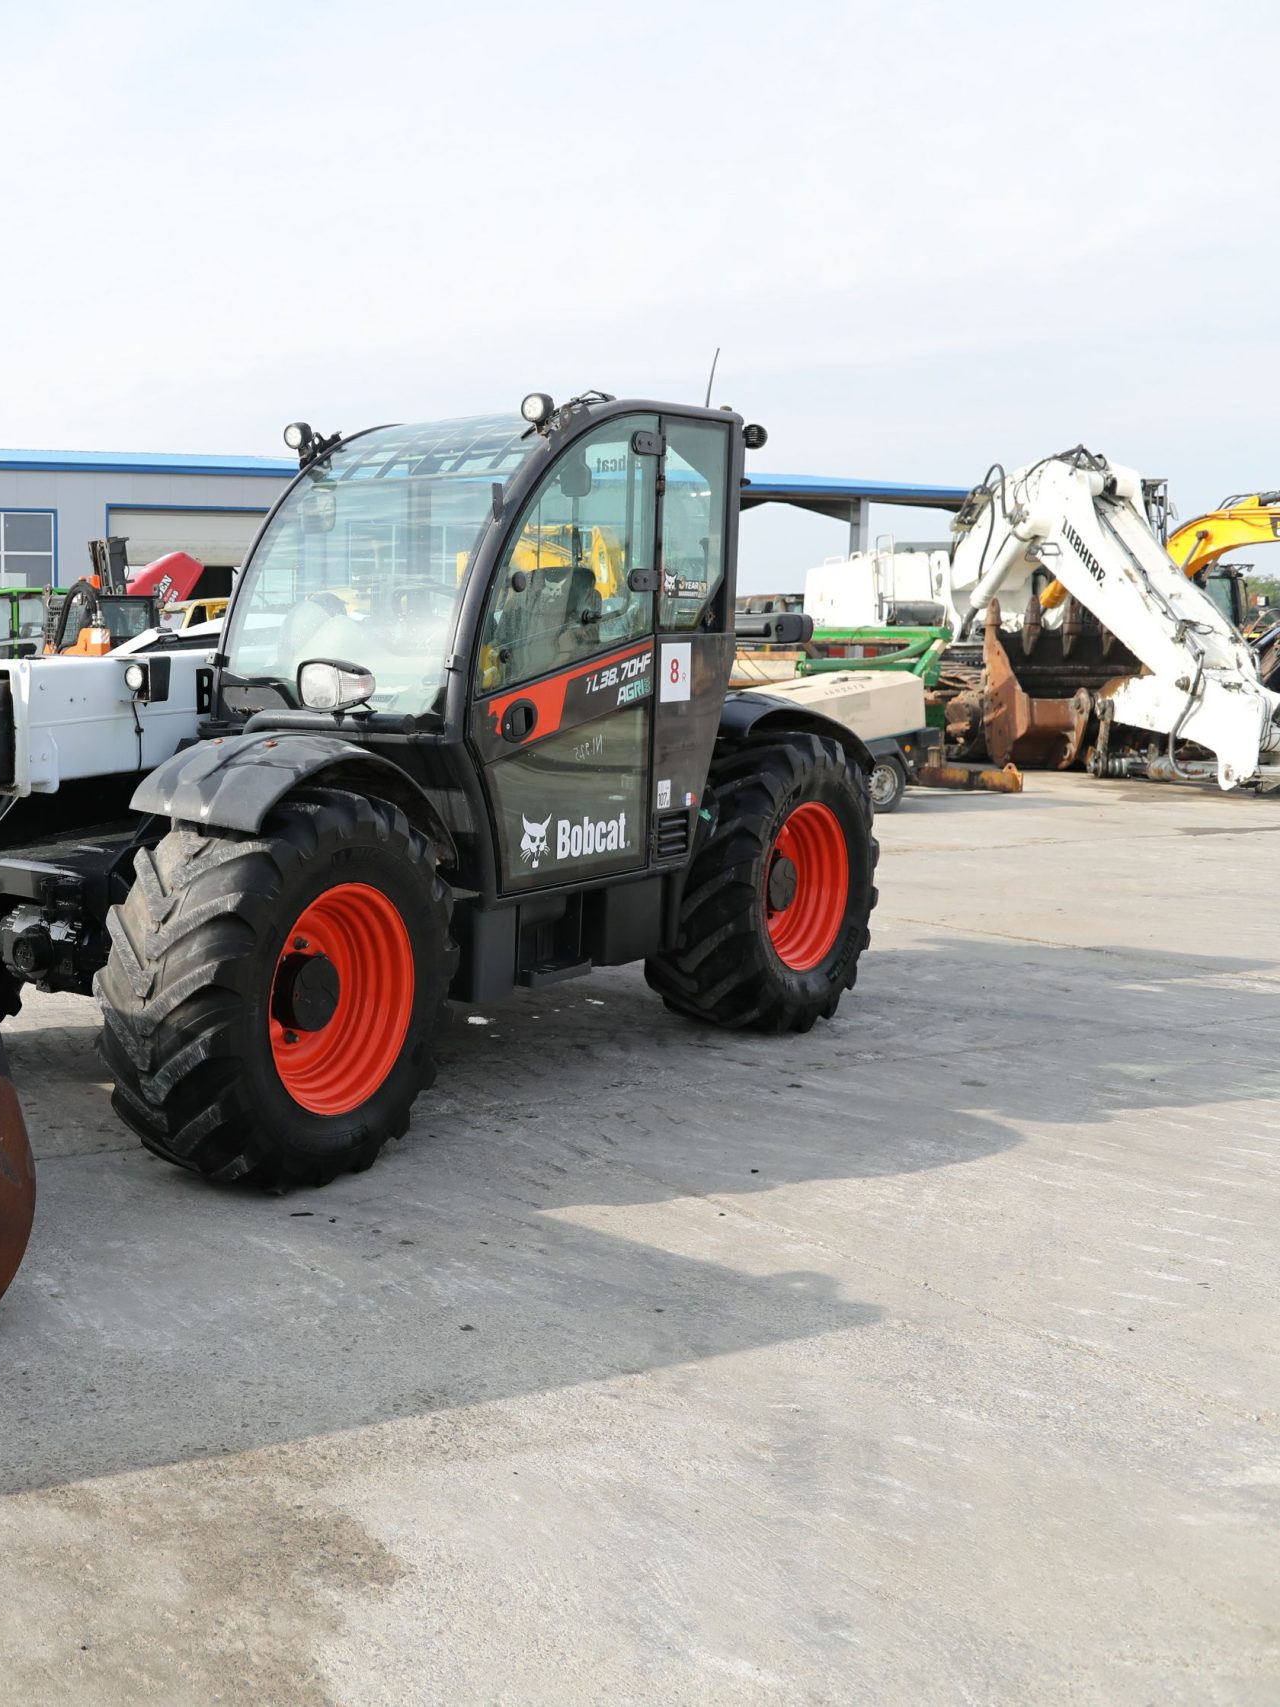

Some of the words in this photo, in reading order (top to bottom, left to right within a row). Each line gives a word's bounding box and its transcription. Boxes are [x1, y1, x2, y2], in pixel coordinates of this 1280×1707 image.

[1061, 516, 1106, 588] LIEBHERR
[686, 581, 699, 590] YEAR
[670, 658, 679, 684] 8
[616, 679, 645, 706] AGRI
[556, 812, 627, 860] Bobcat
